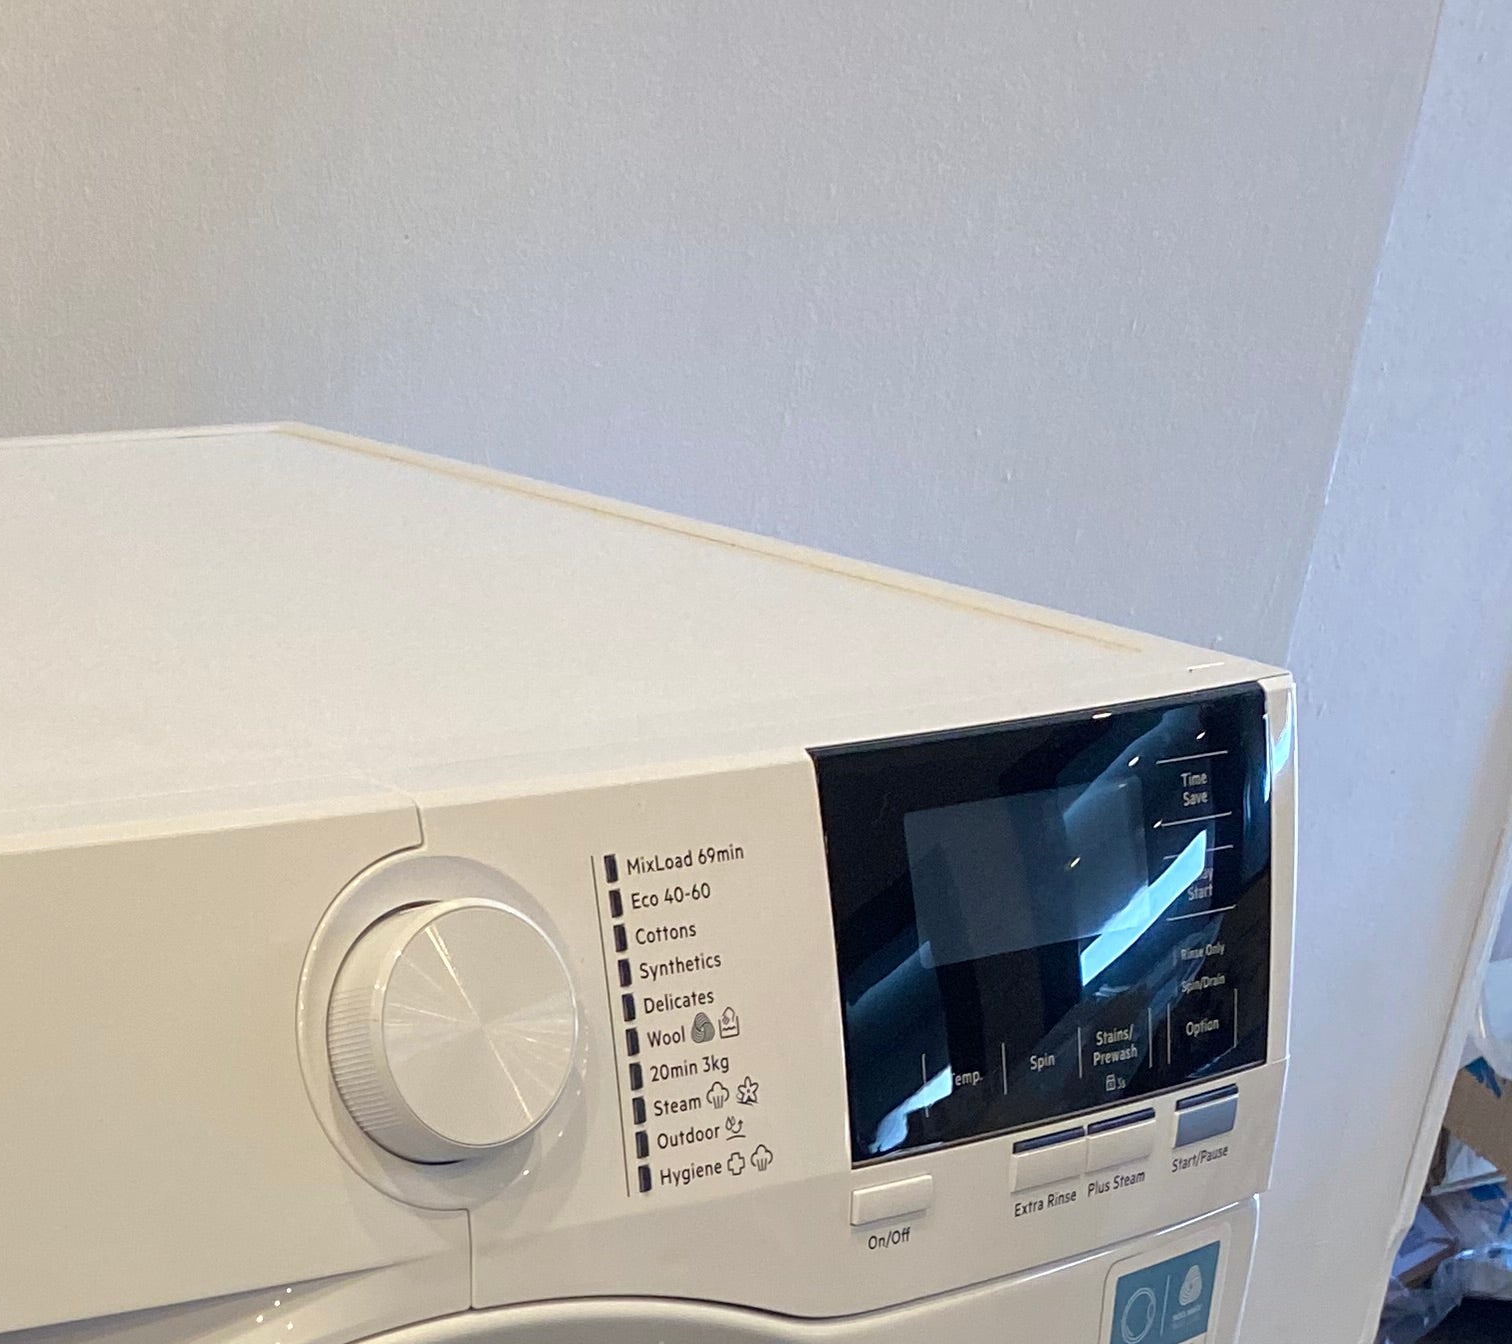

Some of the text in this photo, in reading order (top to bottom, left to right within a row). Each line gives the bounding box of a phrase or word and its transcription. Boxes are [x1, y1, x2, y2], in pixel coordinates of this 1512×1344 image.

[1180, 772, 1208, 787] Time
[1183, 791, 1208, 807] Save
[626, 844, 744, 875] MixLoad 69min
[631, 882, 711, 909] Eco 40-60
[1187, 883, 1213, 901] Start
[635, 924, 697, 945] Cottons
[639, 953, 722, 981] Synthetics
[644, 990, 714, 1014] Delicates
[647, 1025, 686, 1048] Wool
[1096, 1024, 1134, 1046] Stains/
[1186, 1018, 1219, 1037] Option
[1030, 1053, 1056, 1072] Spin
[1093, 1043, 1138, 1067] Prewash
[650, 1054, 729, 1082] 20min 3kg
[654, 1096, 702, 1116] Steam
[657, 1126, 720, 1149] Outdoor
[1172, 1146, 1229, 1173] Start/Pause
[660, 1162, 722, 1187] Hygiene
[1088, 1171, 1145, 1197] Plus Steam
[1014, 1190, 1077, 1218] Extra Rinse
[868, 1227, 911, 1250] On/Off
